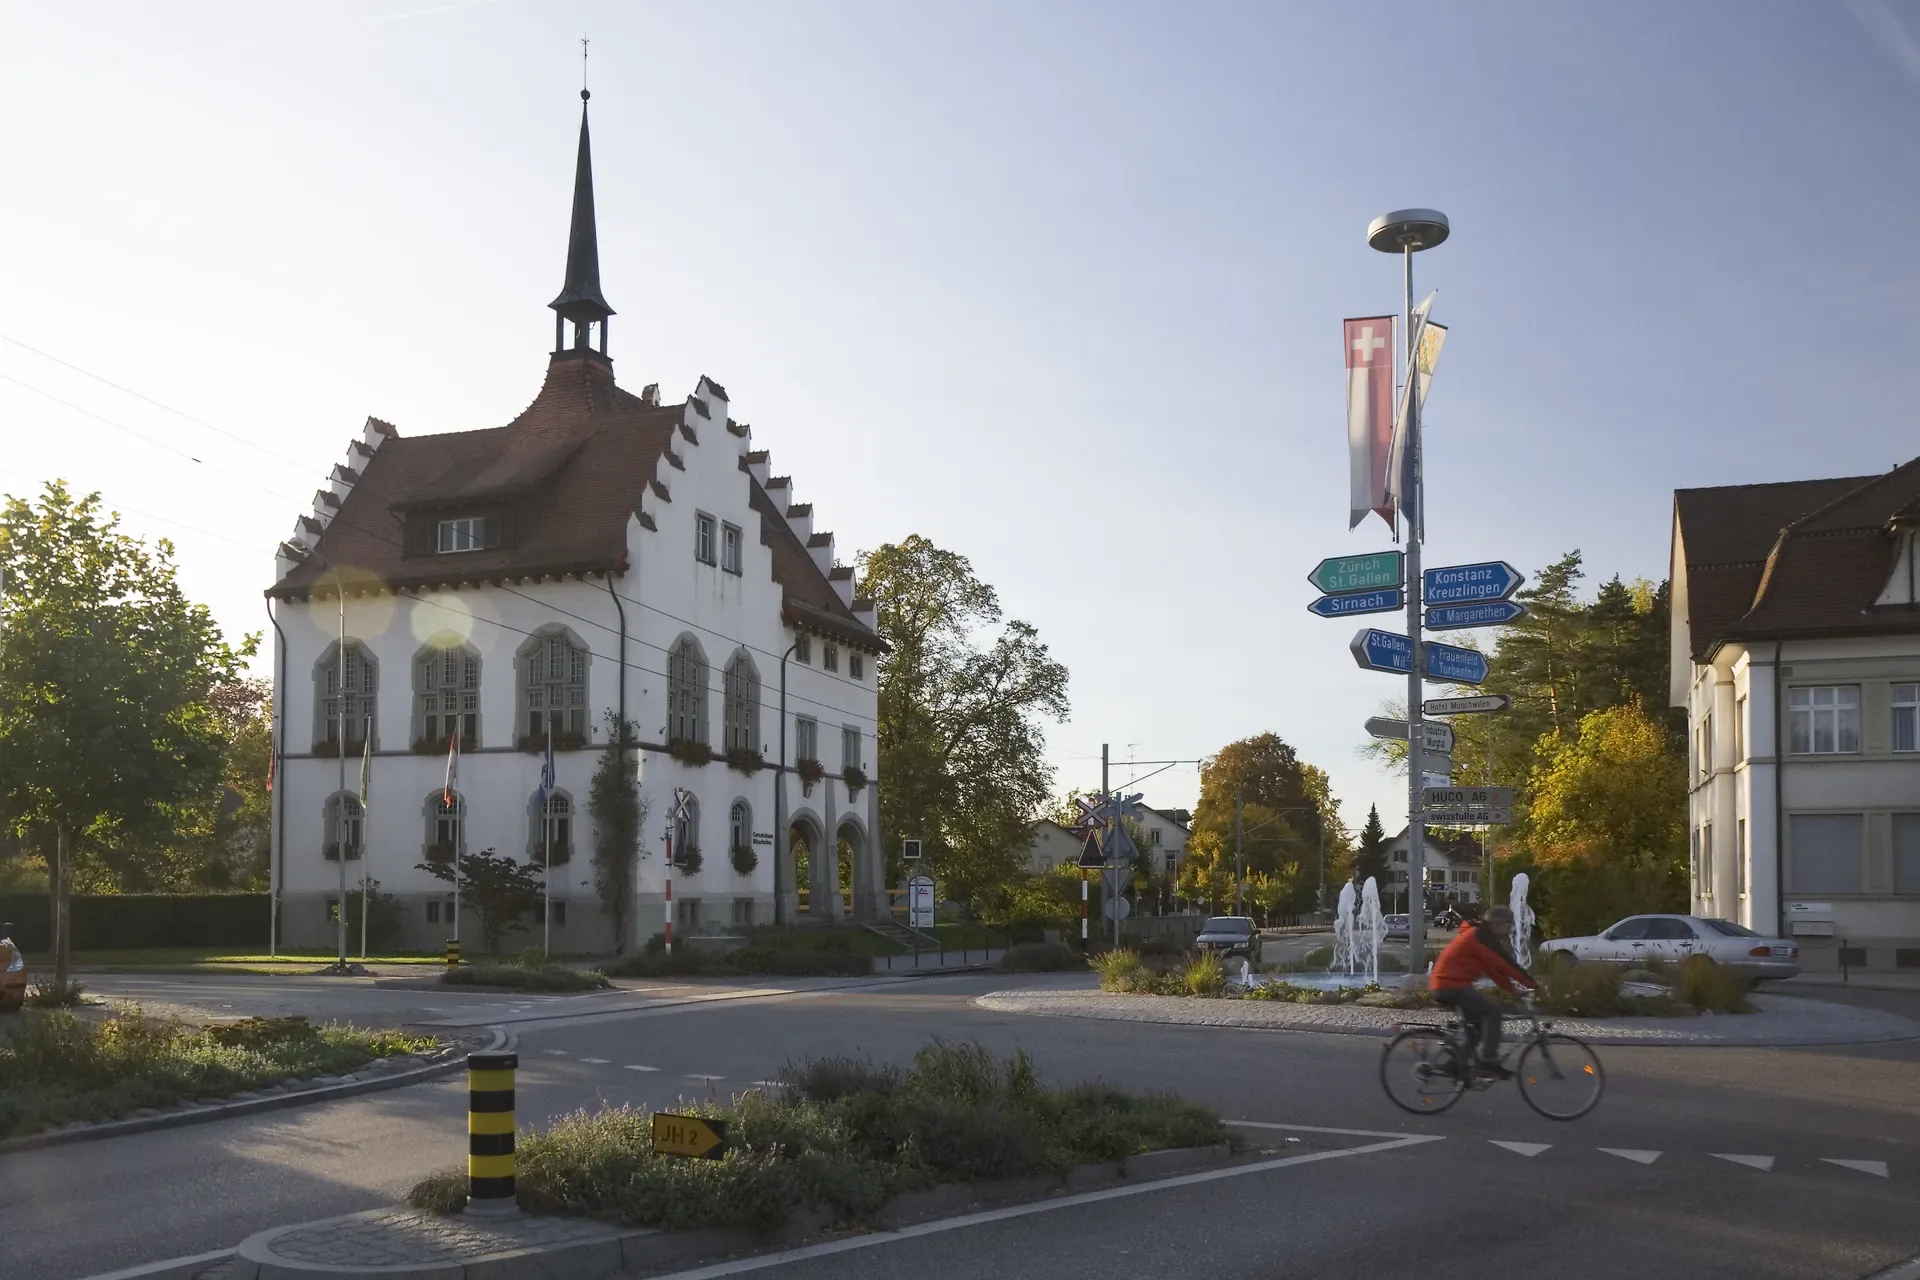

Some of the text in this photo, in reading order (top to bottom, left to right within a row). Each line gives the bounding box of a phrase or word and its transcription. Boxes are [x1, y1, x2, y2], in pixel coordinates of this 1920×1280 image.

[1338, 559, 1380, 573] Zürich
[1435, 569, 1491, 583] Konstanz
[1428, 583, 1500, 600] Kreuzlingen
[1331, 594, 1383, 611] Sirnach
[1446, 606, 1504, 623] Margarethen
[1392, 653, 1406, 667] Wil
[1439, 649, 1478, 666] Frauenfeld
[1439, 662, 1479, 679] Turbenthal
[1430, 703, 1447, 711] Hotel
[1432, 791, 1487, 802] HUCO AG
[1477, 812, 1489, 820] AG
[689, 1129, 698, 1145] 2
